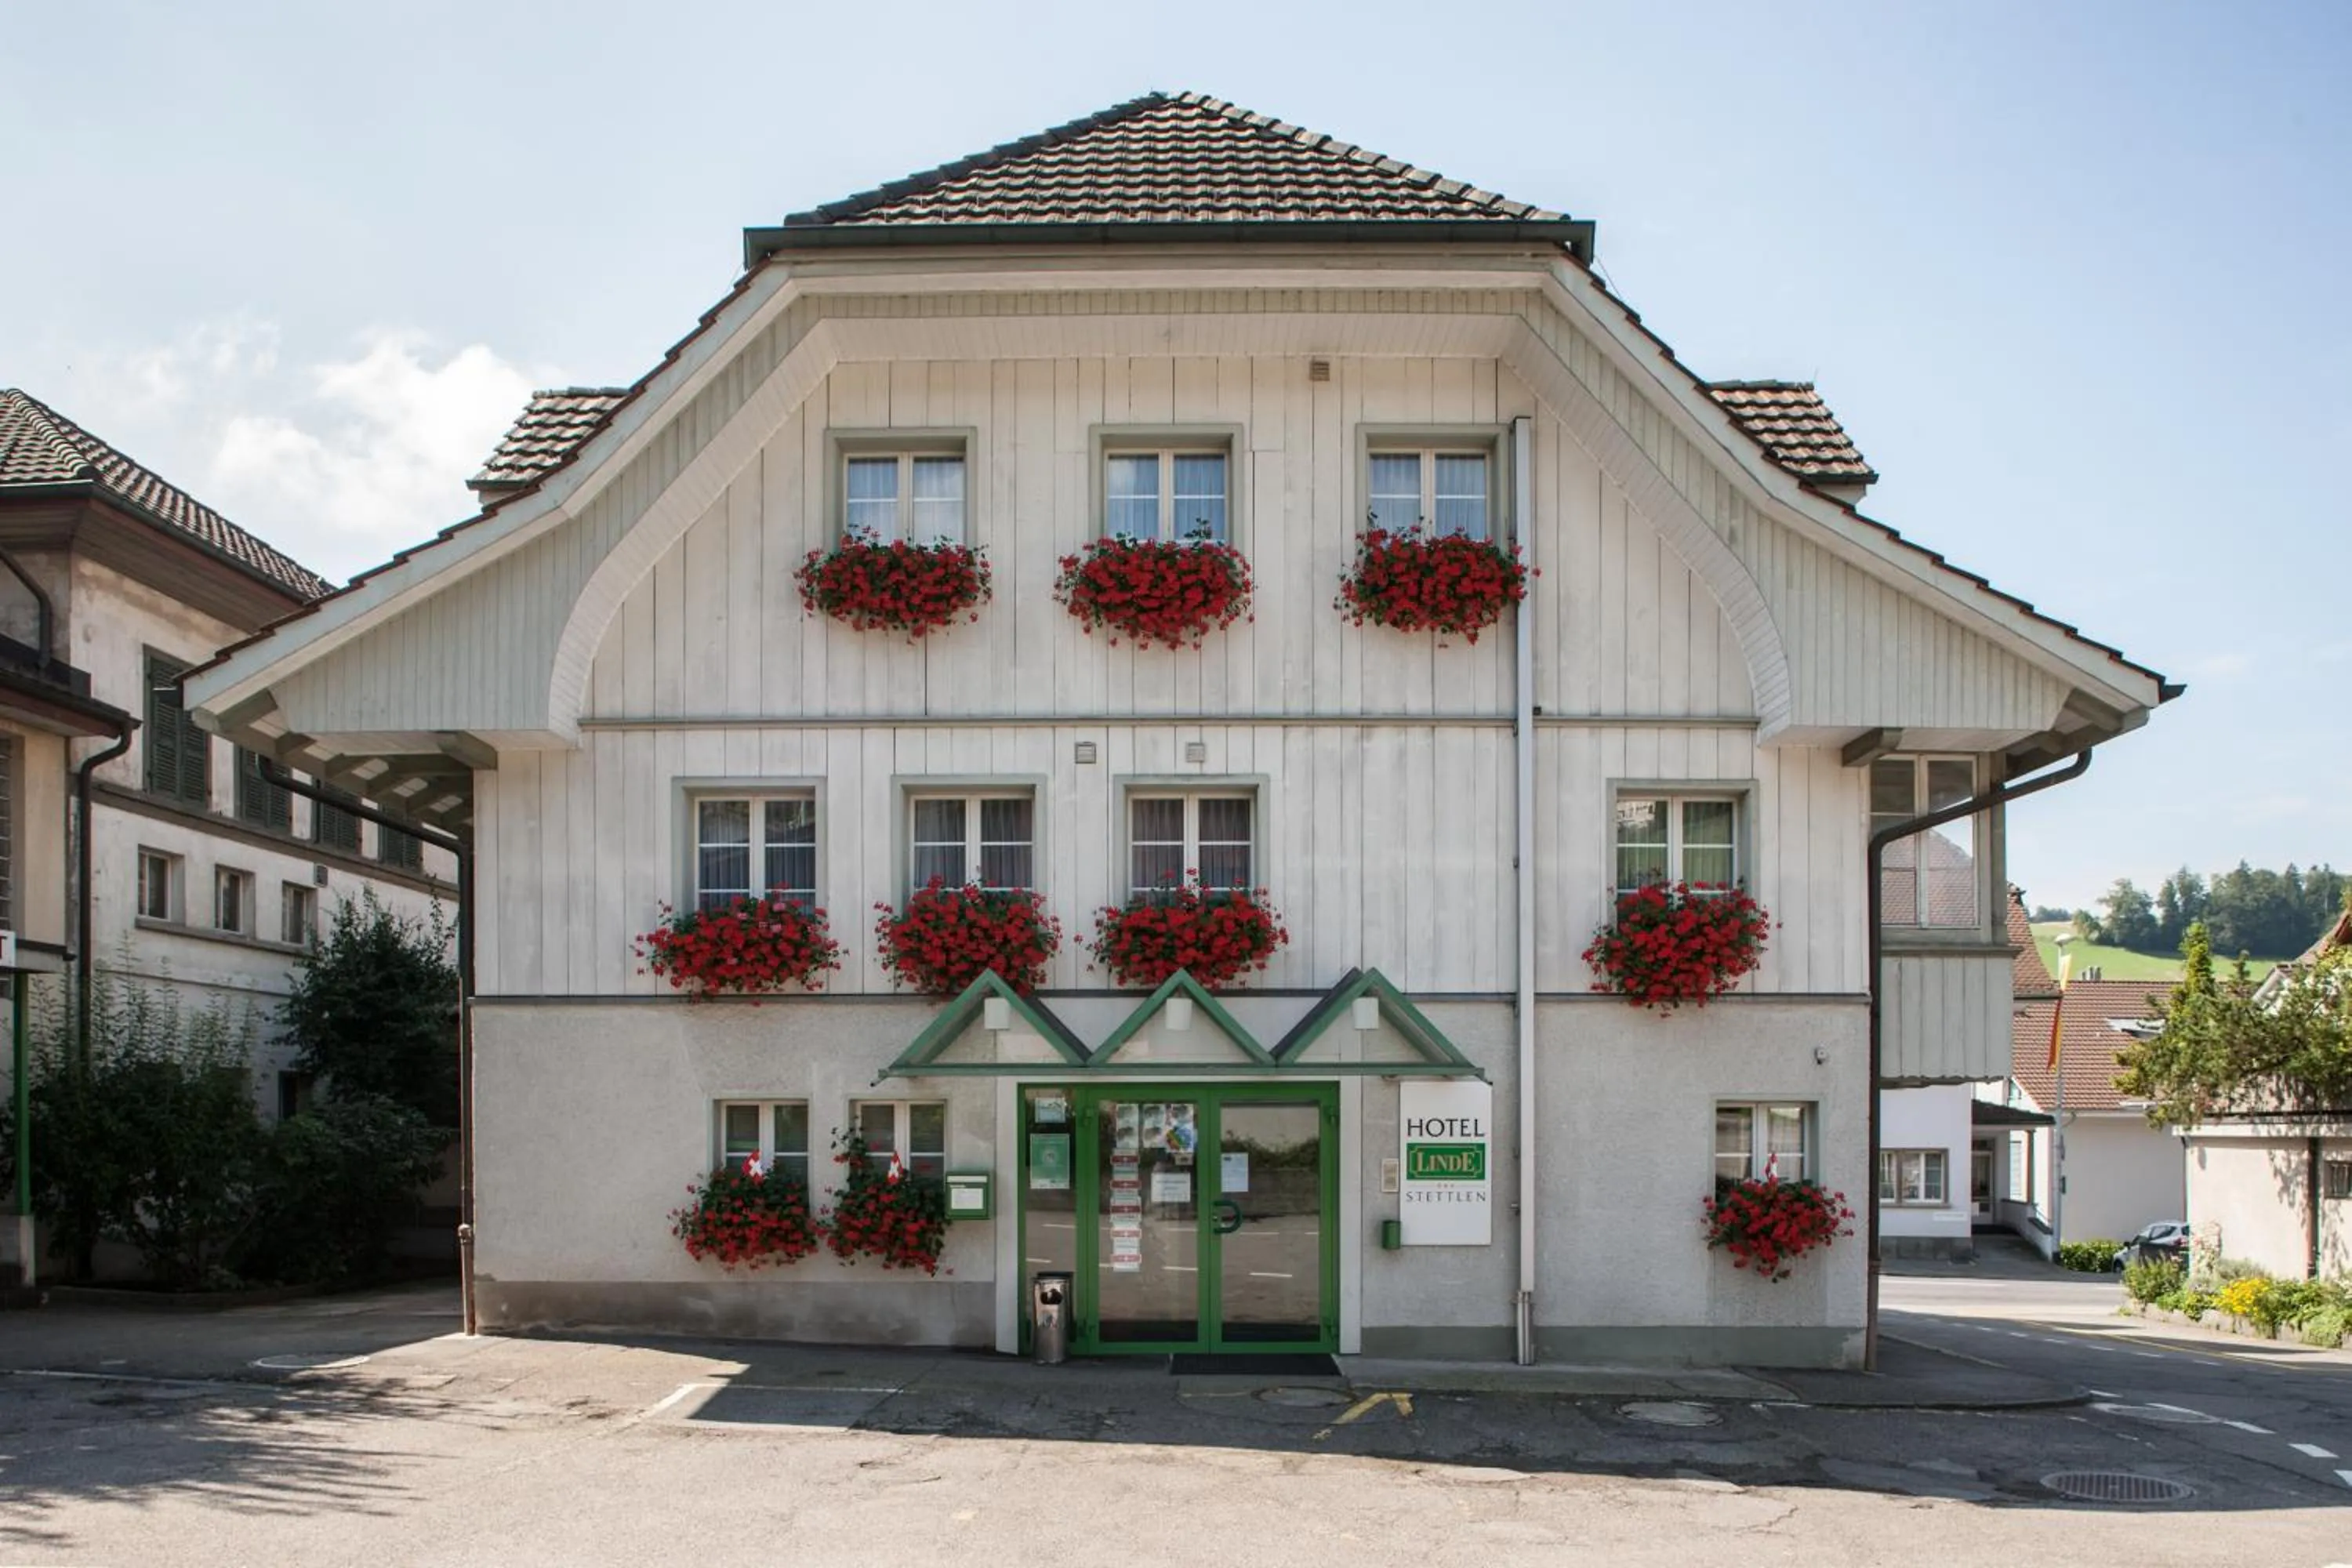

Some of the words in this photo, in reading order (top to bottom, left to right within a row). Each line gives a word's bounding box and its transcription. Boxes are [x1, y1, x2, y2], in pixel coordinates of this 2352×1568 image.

[1407, 1118, 1485, 1138] HOTEL
[1417, 1152, 1475, 1172] LINDE
[1406, 1191, 1486, 1203] STETTLEN
